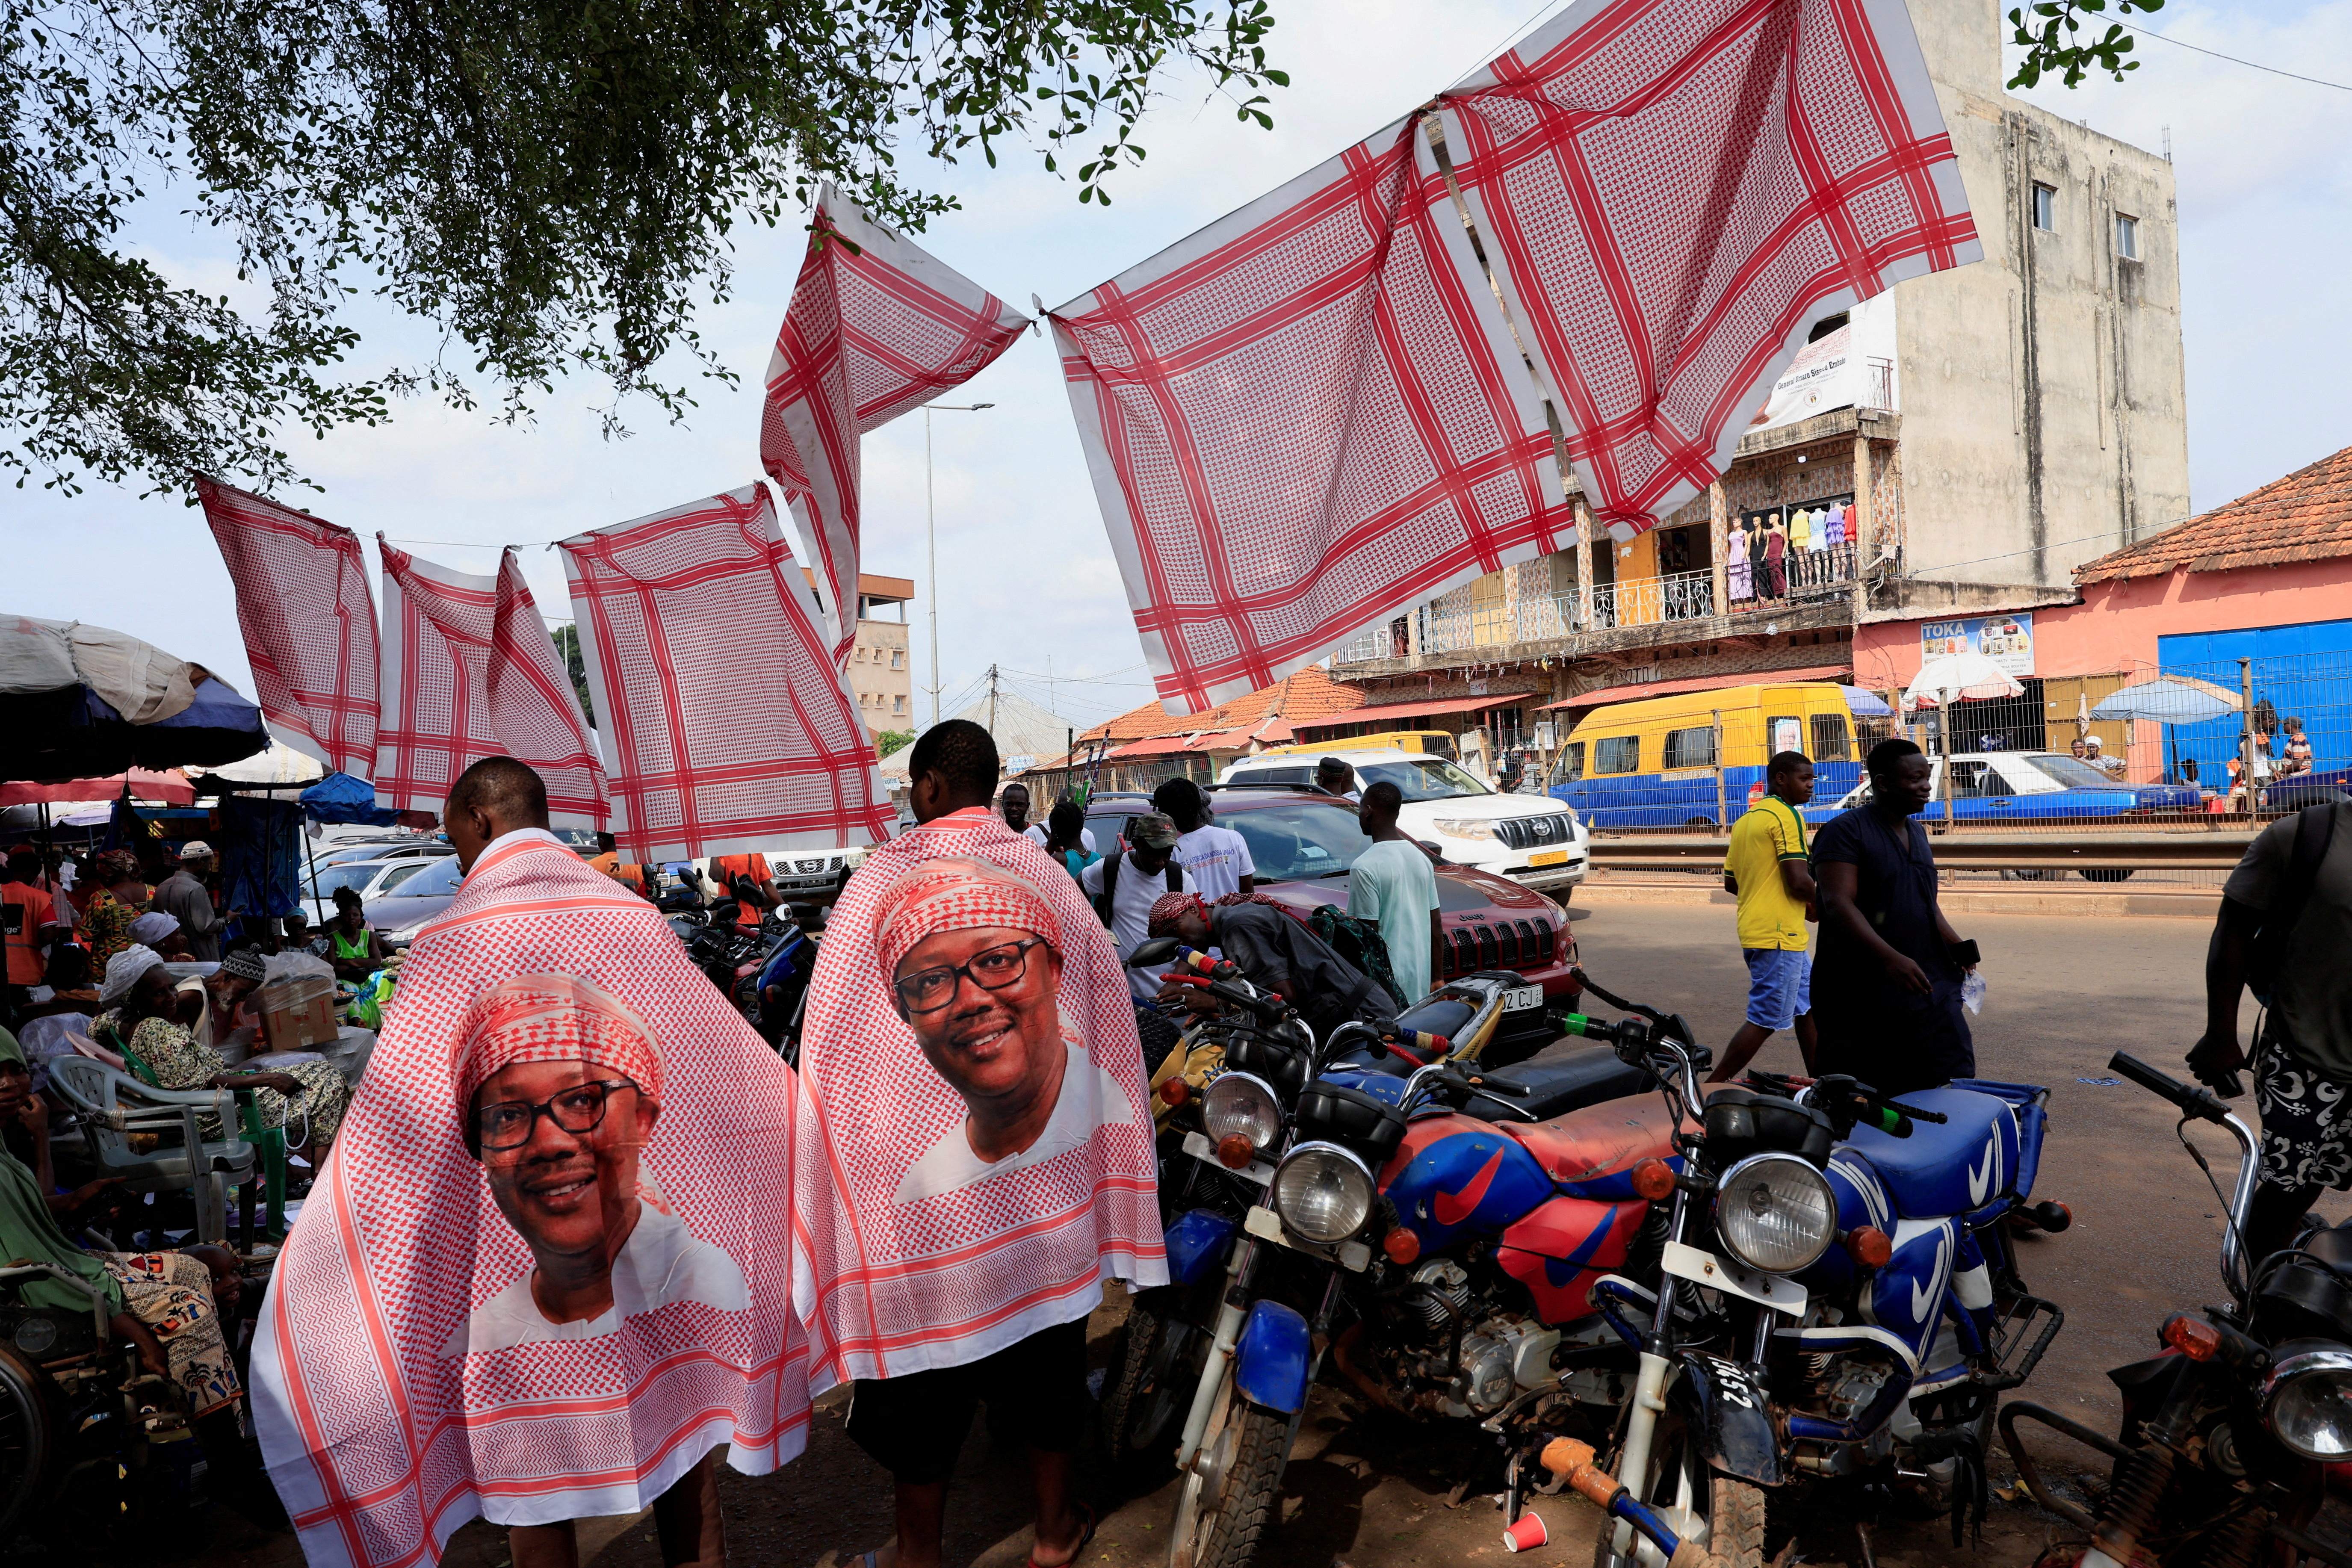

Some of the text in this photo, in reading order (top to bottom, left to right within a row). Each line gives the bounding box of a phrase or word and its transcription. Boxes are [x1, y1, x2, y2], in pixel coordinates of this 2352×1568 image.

[1778, 378, 1795, 390] General
[1796, 373, 1810, 383] Umaro
[1924, 622, 1965, 638] TOKA
[1519, 990, 1532, 1007] CJ
[1485, 1376, 1508, 1393] TVS
